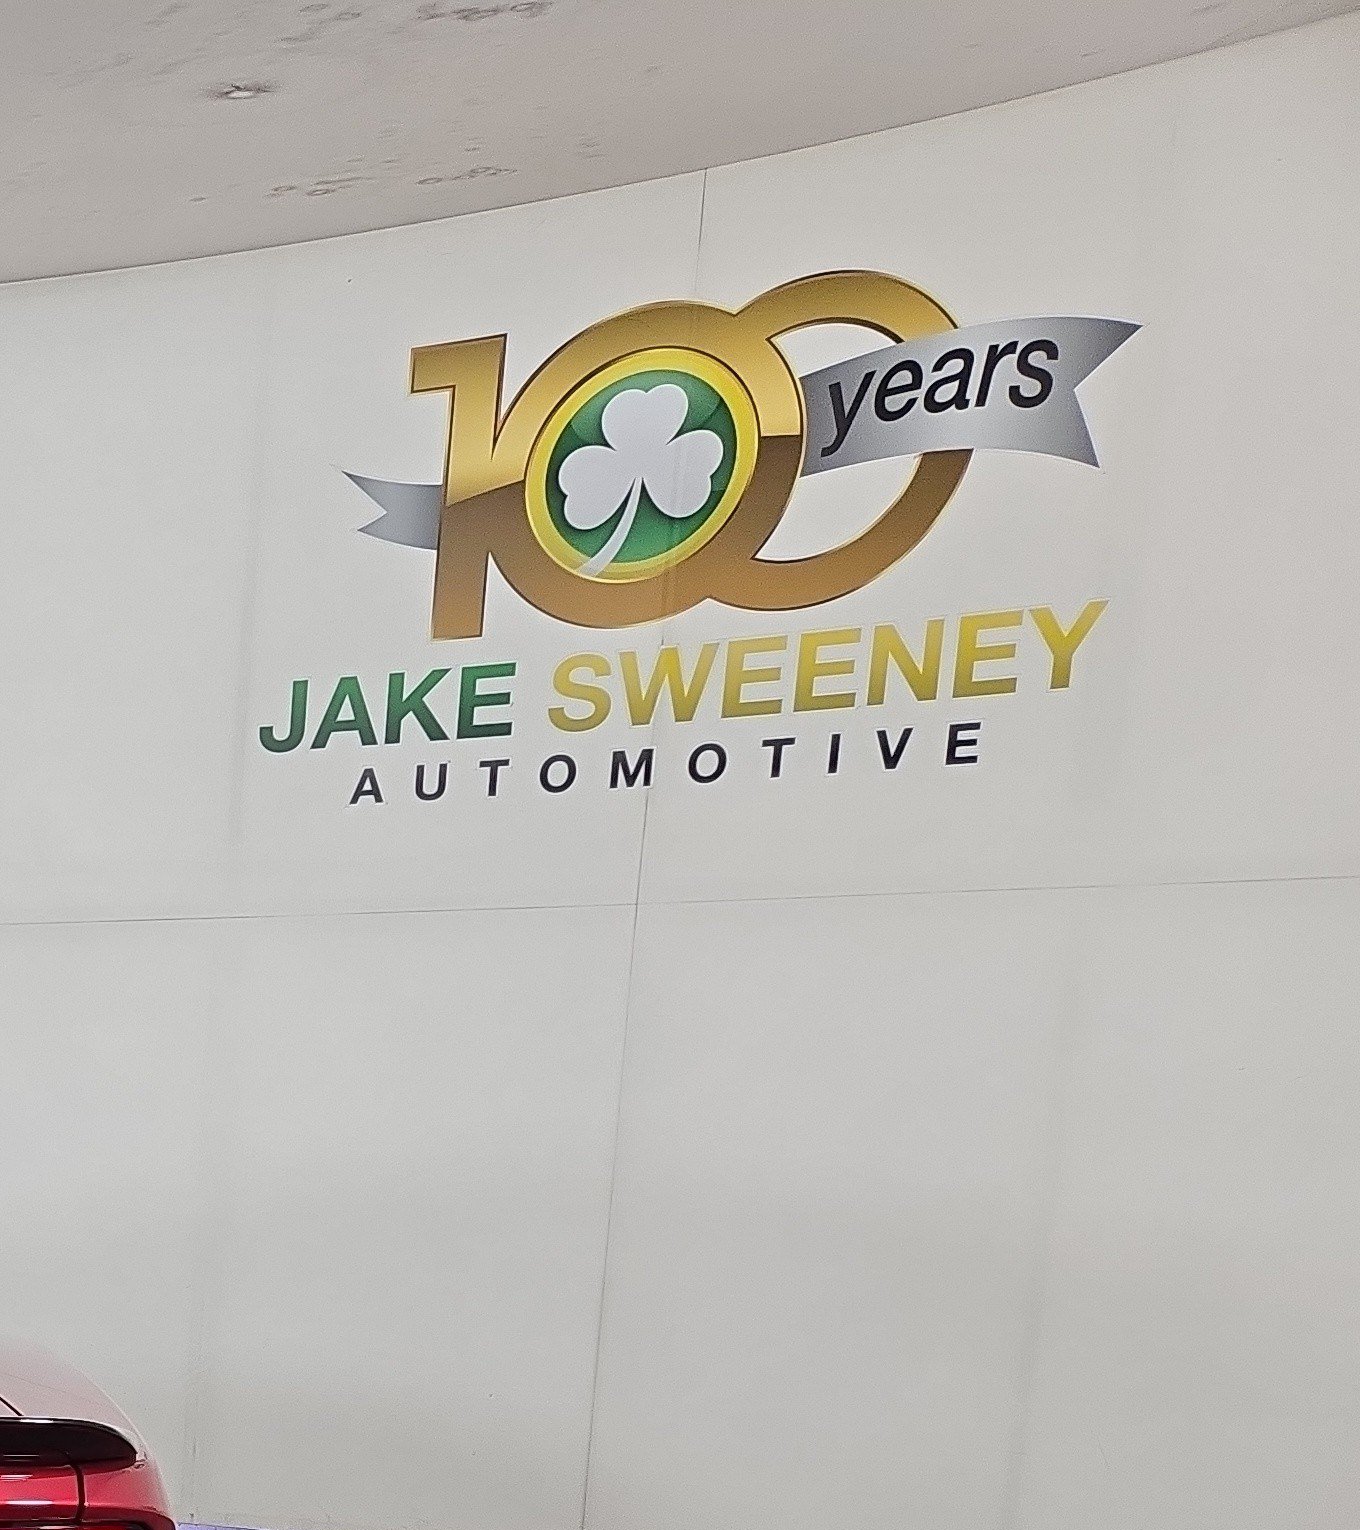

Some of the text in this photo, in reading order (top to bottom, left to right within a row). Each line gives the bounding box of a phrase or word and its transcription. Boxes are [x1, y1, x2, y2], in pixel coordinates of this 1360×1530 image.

[410, 269, 1060, 642] 100 years
[258, 599, 1109, 755] JAKE SWEENEY
[348, 720, 983, 806] AUTOMOTIVE
